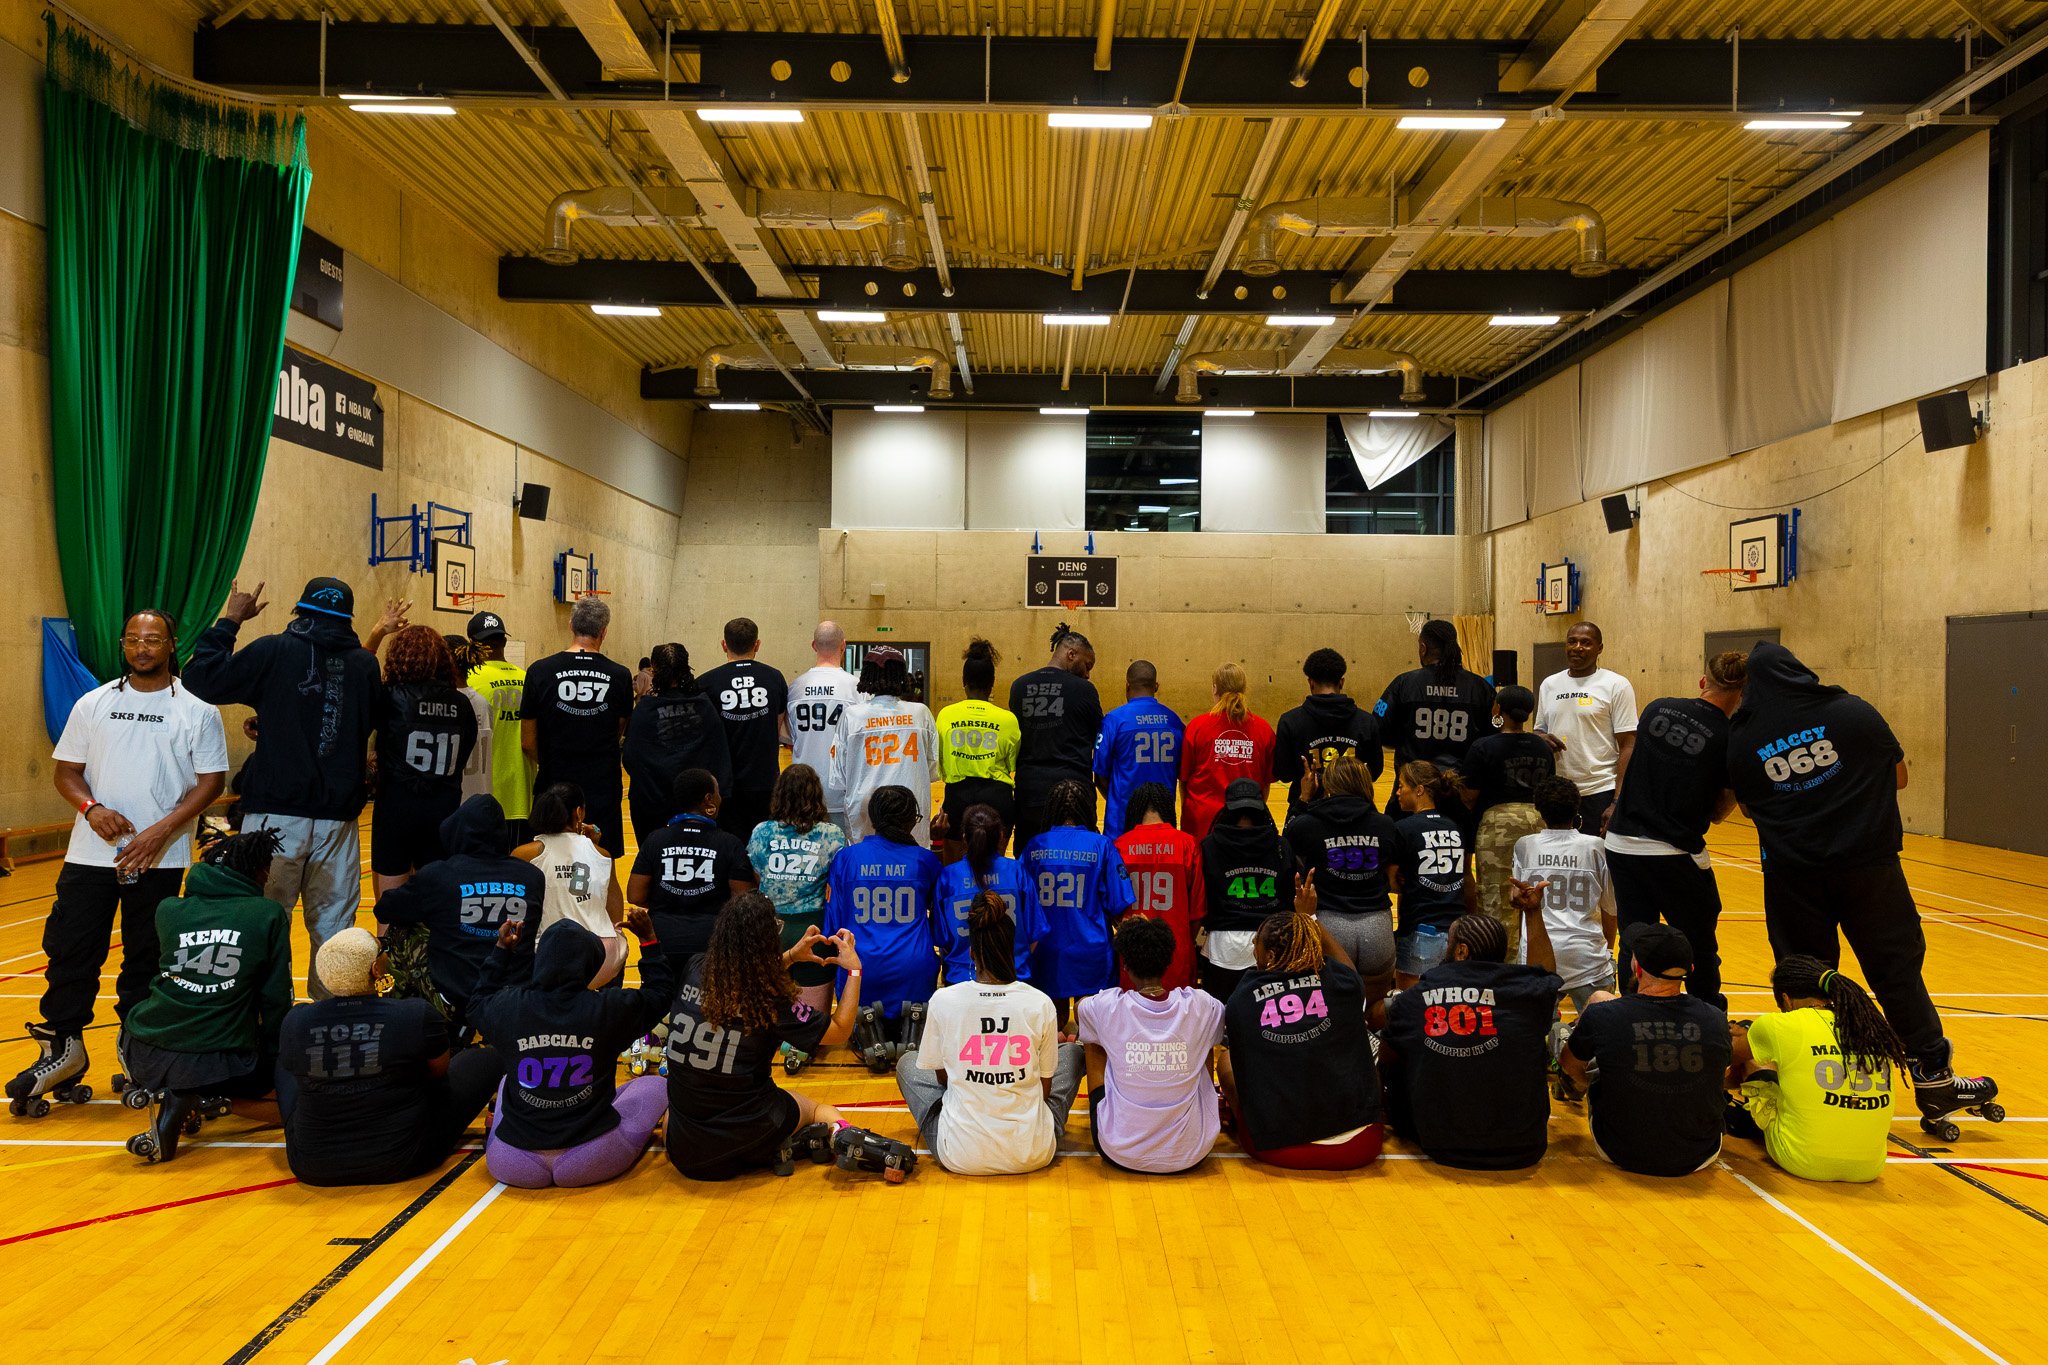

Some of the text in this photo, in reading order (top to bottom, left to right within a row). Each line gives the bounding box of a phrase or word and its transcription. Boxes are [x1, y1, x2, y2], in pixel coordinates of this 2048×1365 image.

[319, 258, 343, 283] GUESTS
[274, 364, 326, 432] nba
[348, 400, 372, 421] NBA UK
[347, 426, 375, 448] @NBAUK
[1057, 561, 1088, 572] DENG
[489, 679, 525, 689] MARSH
[555, 669, 612, 682] BACKWARDS
[731, 675, 755, 689] CB
[493, 688, 521, 709] 00
[557, 680, 610, 703] 057
[720, 686, 769, 711] 918
[805, 686, 835, 696] SHANE
[1026, 683, 1063, 697] DEE
[1426, 685, 1459, 698] DANIEL
[110, 711, 165, 723] SK8 M8S
[418, 701, 458, 718] CURLS
[499, 710, 521, 721] JAS
[657, 703, 697, 720] MAX
[796, 703, 844, 732] 994
[1021, 696, 1065, 718] 524
[865, 714, 913, 729] JENNYBEE
[951, 720, 1000, 731] MARSHAL
[1135, 714, 1168, 725] SMERFF
[1415, 707, 1469, 742] 988
[950, 729, 999, 751] 008
[1231, 739, 1254, 747] THINGS
[1309, 735, 1358, 748] SIMPLY_BOYCE
[1647, 715, 1706, 755] 089
[1756, 725, 1827, 763] MACCY
[405, 729, 461, 777] 611
[864, 732, 919, 767] 624
[951, 750, 996, 760] ANTOINETTE
[1134, 731, 1175, 763] 212
[1214, 745, 1253, 755] COME TO
[1763, 738, 1840, 783] 068
[769, 838, 821, 854] SAUCE
[1128, 843, 1175, 856] KING KAI
[1324, 835, 1380, 849] HANNA
[1421, 830, 1462, 849] KES
[661, 846, 718, 860] JEMSTER
[768, 852, 819, 875] 027
[1030, 850, 1098, 863] PERFECTLYSIZED
[1326, 848, 1380, 870] 993
[1417, 848, 1465, 875] 257
[1537, 854, 1578, 868] UBAAH
[555, 865, 576, 873] HAVE
[660, 857, 715, 883] 154
[766, 873, 798, 882] CHOPPIN
[860, 864, 907, 877] NAT NAT
[459, 881, 526, 898] DUBBS
[576, 893, 592, 903] DAY
[1038, 871, 1086, 909] 821
[1129, 871, 1174, 912] 119
[1227, 876, 1277, 899] 414
[460, 896, 528, 924] 579
[853, 886, 916, 924] 980
[179, 929, 242, 948] KEMI
[169, 945, 243, 977] 145
[162, 971, 237, 994] COPPIN IT UP
[1252, 974, 1322, 1003] LEE LEE
[1421, 986, 1496, 1007] WHOA
[1259, 989, 1329, 1028] 494
[980, 1016, 1010, 1034] DJ
[1261, 1017, 1332, 1044] CHOPPIN IT UP
[1423, 1004, 1498, 1037] 801
[309, 1023, 385, 1044] TORI
[1631, 1021, 1702, 1042] KILO
[517, 1034, 595, 1052] BABCIA.C
[666, 1012, 742, 1075] 291
[958, 1034, 1032, 1066] 473
[1125, 1041, 1188, 1052] GOOD THINGS
[1424, 1036, 1500, 1058] CHOPPIN IT UP
[305, 1041, 383, 1079] 111
[1125, 1050, 1188, 1065] COME TO
[1148, 1064, 1167, 1072] WHO
[1166, 1063, 1188, 1072] SKATE
[1631, 1043, 1704, 1073] 186
[517, 1054, 594, 1089] 072
[965, 1067, 1027, 1086] NIQUE J
[518, 1085, 594, 1109] CHOPPIN IT UP
[1823, 1091, 1891, 1111] DREDD
